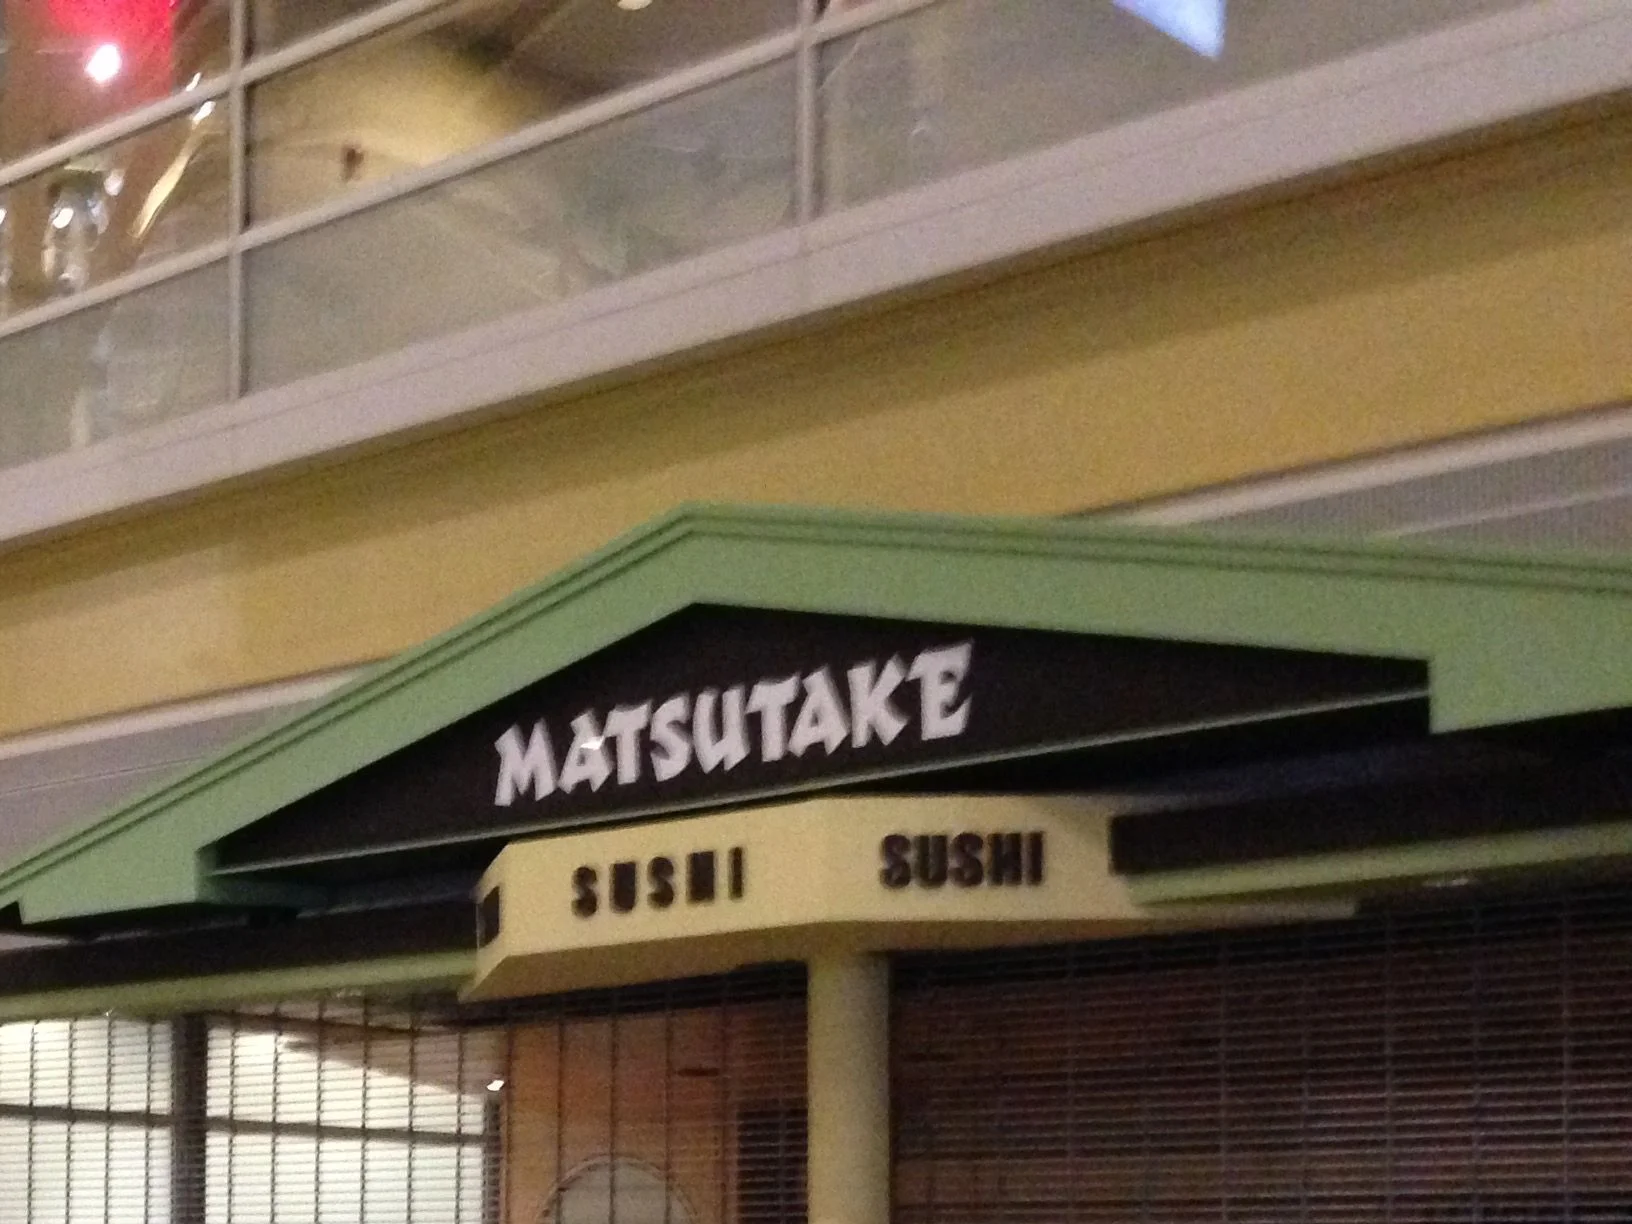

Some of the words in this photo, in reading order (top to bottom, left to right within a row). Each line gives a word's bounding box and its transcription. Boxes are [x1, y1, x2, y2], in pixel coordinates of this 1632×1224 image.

[493, 641, 974, 808] MATSUTAKE
[572, 846, 746, 919] SUSHI
[879, 830, 1046, 888] SUSHI
